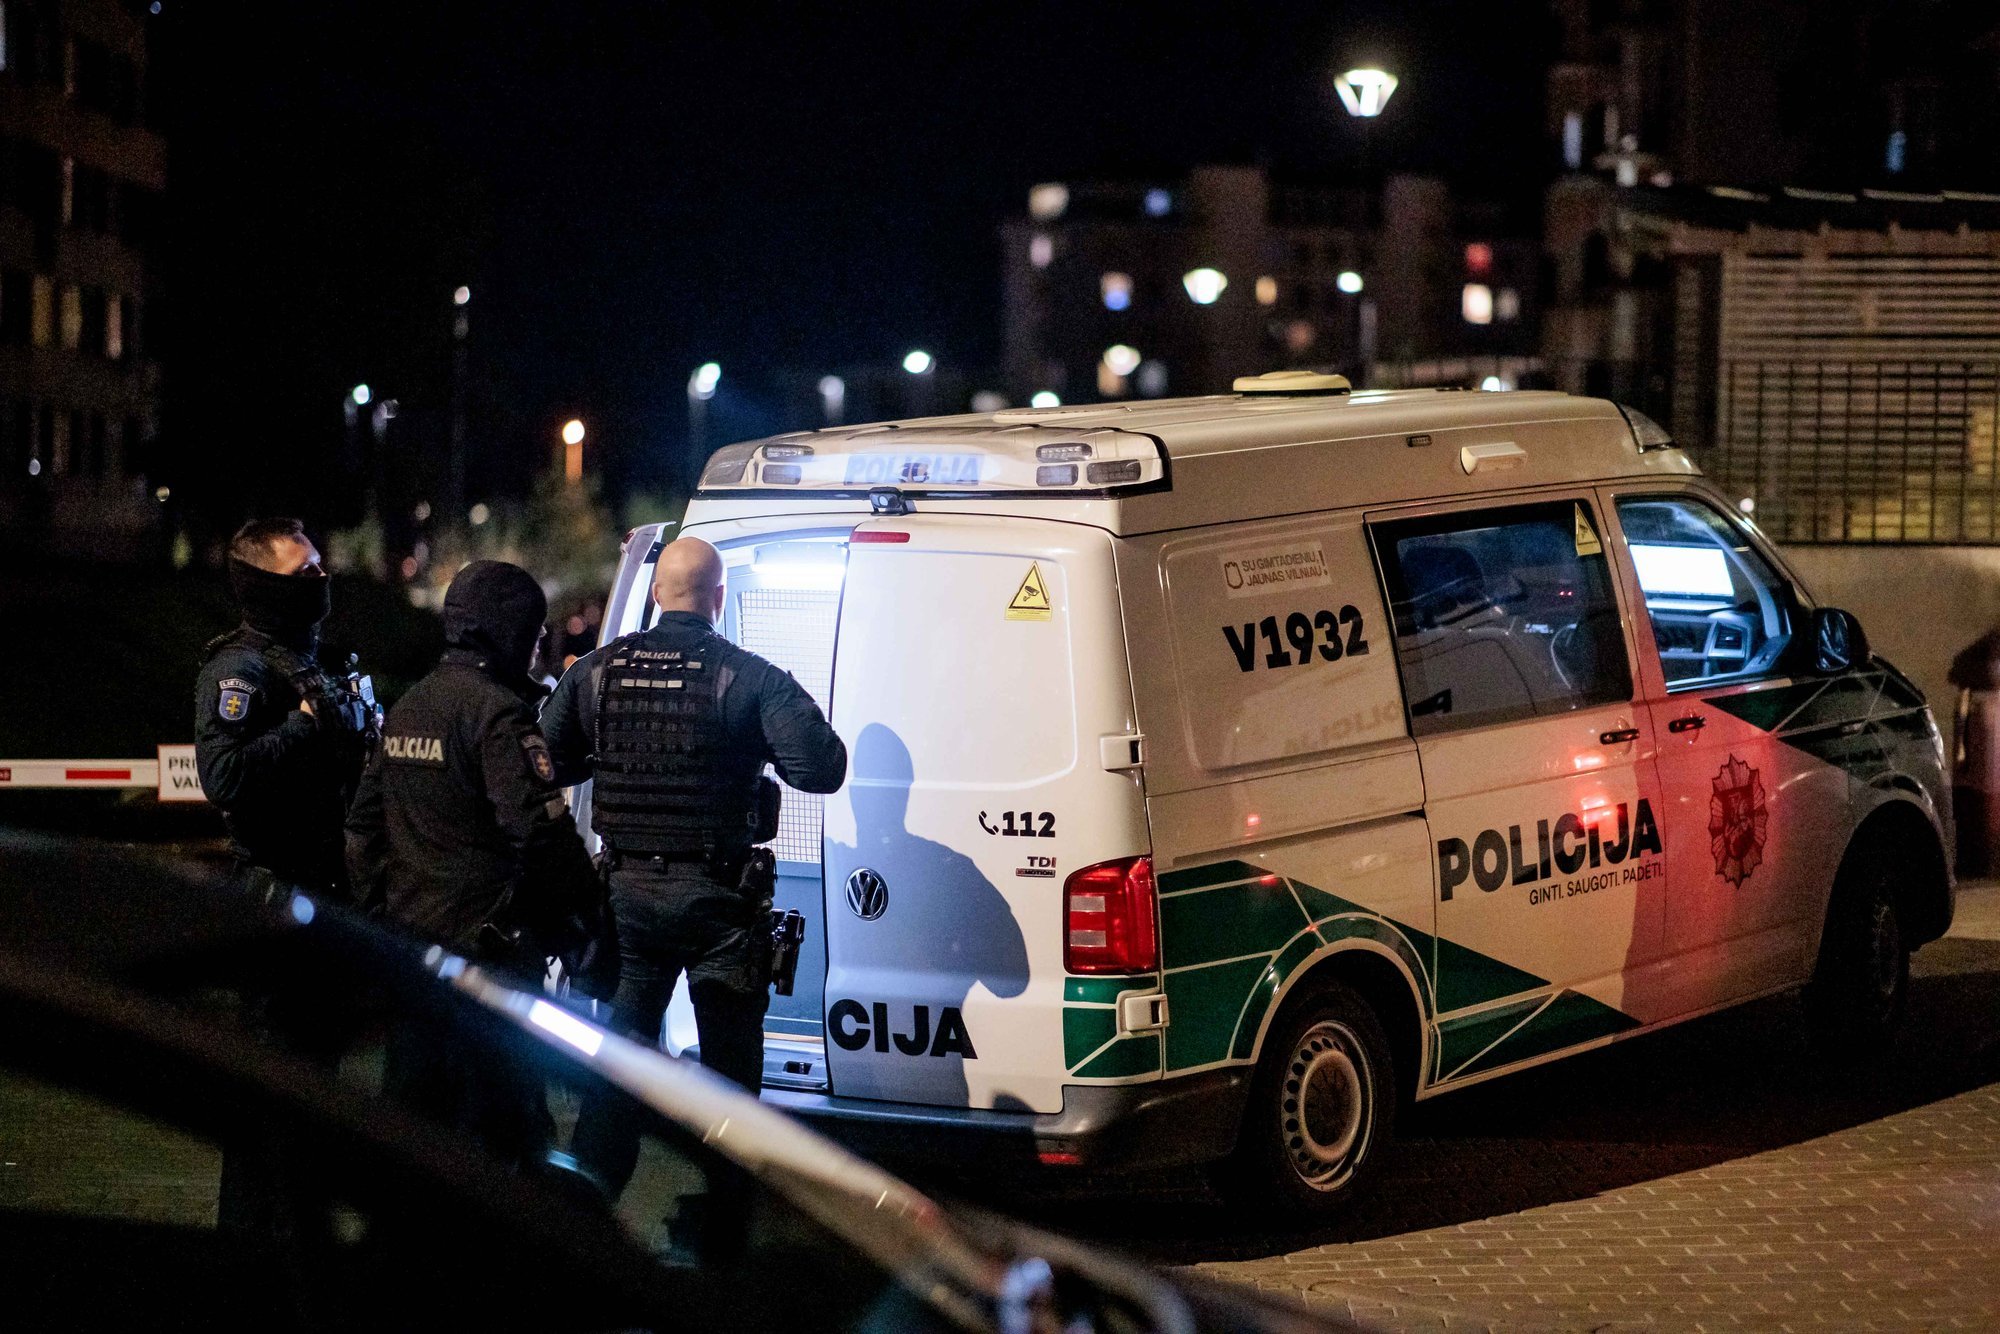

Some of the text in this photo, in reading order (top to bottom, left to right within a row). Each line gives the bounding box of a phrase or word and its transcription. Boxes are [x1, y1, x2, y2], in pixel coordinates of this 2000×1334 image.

[844, 455, 979, 485] POLICIJA
[1242, 559, 1256, 572] SU
[1246, 570, 1285, 586] JAUNAS
[1222, 604, 1369, 672] V1932
[633, 650, 681, 659] POLICIJA
[222, 680, 253, 692] LIETUVA
[1002, 811, 1056, 838] 112
[1027, 856, 1057, 868] TDI
[1437, 798, 1662, 902] POLICIJA
[1529, 884, 1564, 905] GINTI.
[1567, 871, 1620, 897] SAUGOTI.
[828, 998, 978, 1060] CIJA
